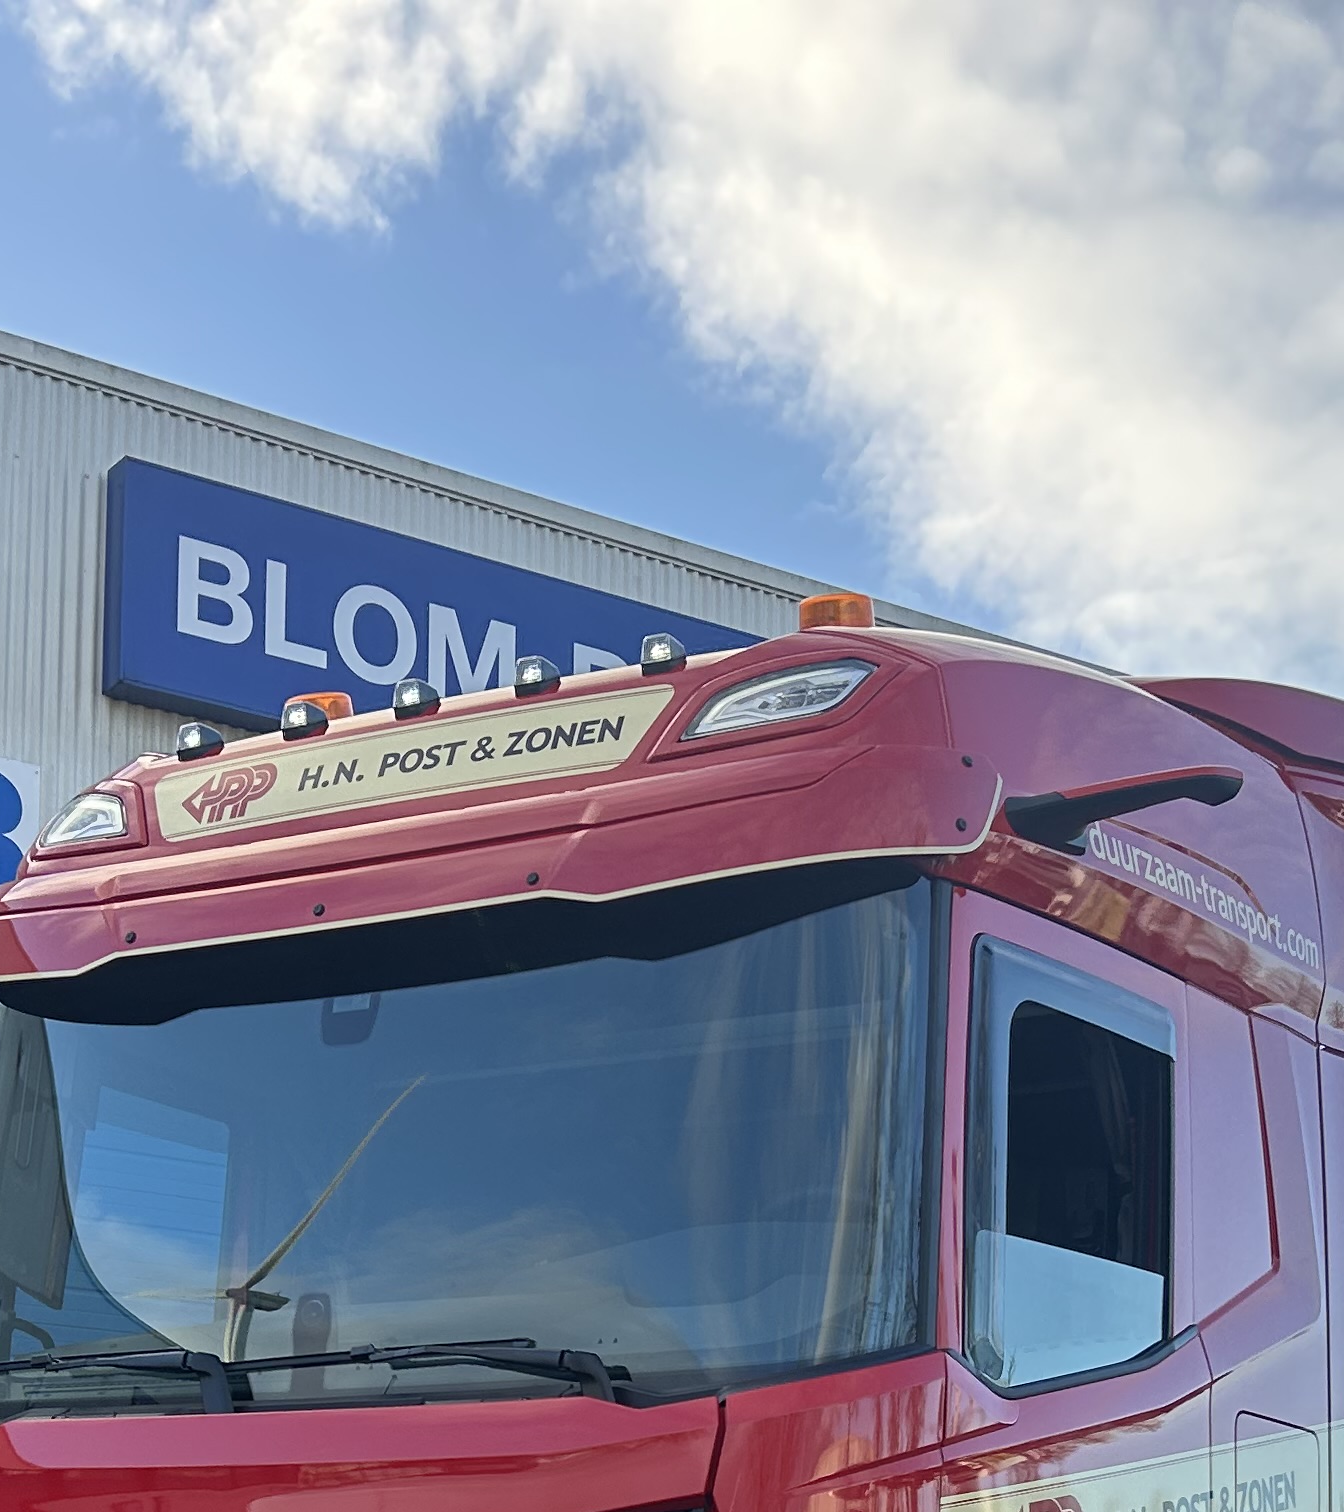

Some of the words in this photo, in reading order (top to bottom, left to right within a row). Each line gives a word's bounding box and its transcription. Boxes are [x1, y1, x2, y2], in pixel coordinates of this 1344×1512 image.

[177, 534, 518, 694] BLOM
[297, 758, 365, 792] H.N.
[378, 740, 468, 778] POST
[470, 735, 495, 763] &
[503, 716, 626, 756] ZONEN
[1088, 820, 1320, 970] duurzaam-transport.com
